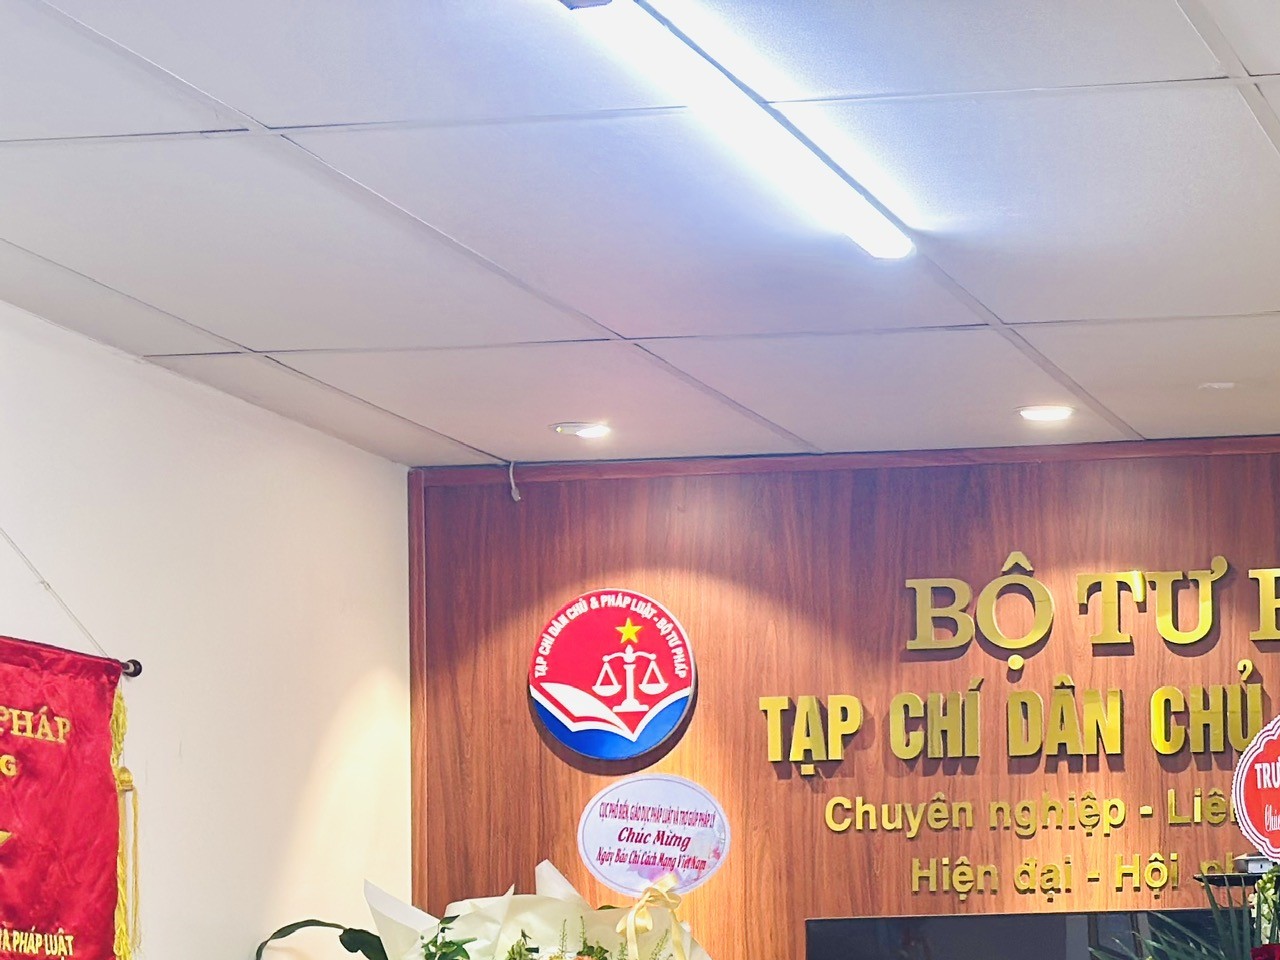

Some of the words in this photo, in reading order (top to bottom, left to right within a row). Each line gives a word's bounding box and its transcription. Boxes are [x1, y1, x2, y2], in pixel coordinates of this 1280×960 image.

[566, 597, 589, 620] CHỦ
[590, 596, 599, 610] &
[601, 592, 631, 609] PHÁP
[630, 598, 657, 620] LUẬT
[906, 551, 1055, 670] BỘ
[1076, 555, 1228, 645] TƯ
[547, 614, 570, 637] DÂN
[656, 617, 674, 636] BỘ
[538, 633, 555, 656] CHÍ
[666, 630, 682, 648] TƯ
[535, 656, 548, 678] TẠP
[671, 646, 689, 679] PHÁP
[759, 694, 864, 775] TẠP
[889, 676, 984, 760] CHÍ
[1008, 673, 1121, 758] DÂN
[1151, 659, 1262, 755] CHỦ
[825, 792, 973, 839] Chuyên
[990, 791, 1125, 836] nghiệp
[1139, 806, 1153, 816] -
[1265, 804, 1280, 832] Chúc
[618, 827, 651, 844] Chúc
[653, 830, 691, 852] Mừng
[596, 846, 614, 866] Ngày
[614, 847, 628, 863] Báo
[628, 850, 640, 865] Chí
[640, 850, 657, 866] Cách
[656, 853, 677, 872] Mạng
[677, 854, 691, 872] Việt
[691, 856, 707, 871] Nam
[912, 855, 997, 900] Hiện
[1014, 855, 1072, 902] đại
[1087, 871, 1100, 881] -
[1115, 853, 1178, 898] Hội
[12, 925, 42, 955] PHÁP
